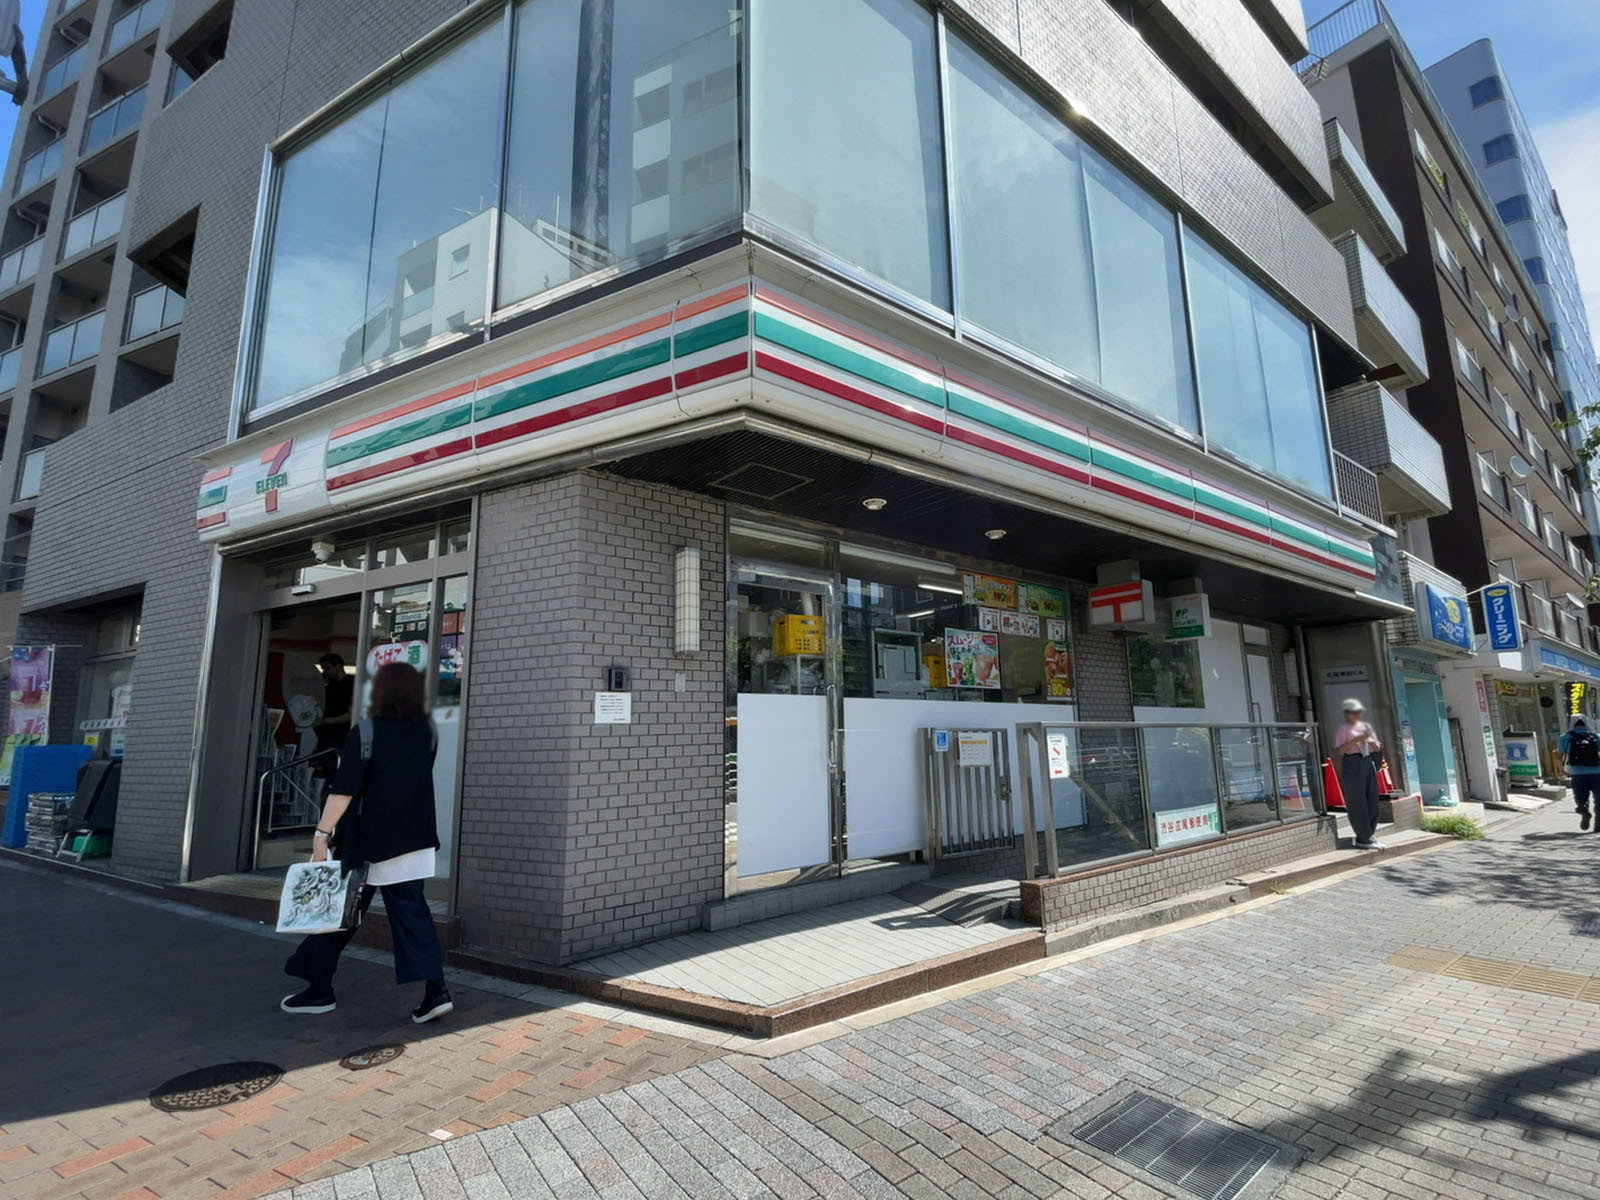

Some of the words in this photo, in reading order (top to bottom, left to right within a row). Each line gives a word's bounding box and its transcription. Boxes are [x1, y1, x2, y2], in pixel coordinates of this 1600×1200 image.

[260, 437, 295, 513] 7
[1492, 597, 1513, 645] クリーニング
